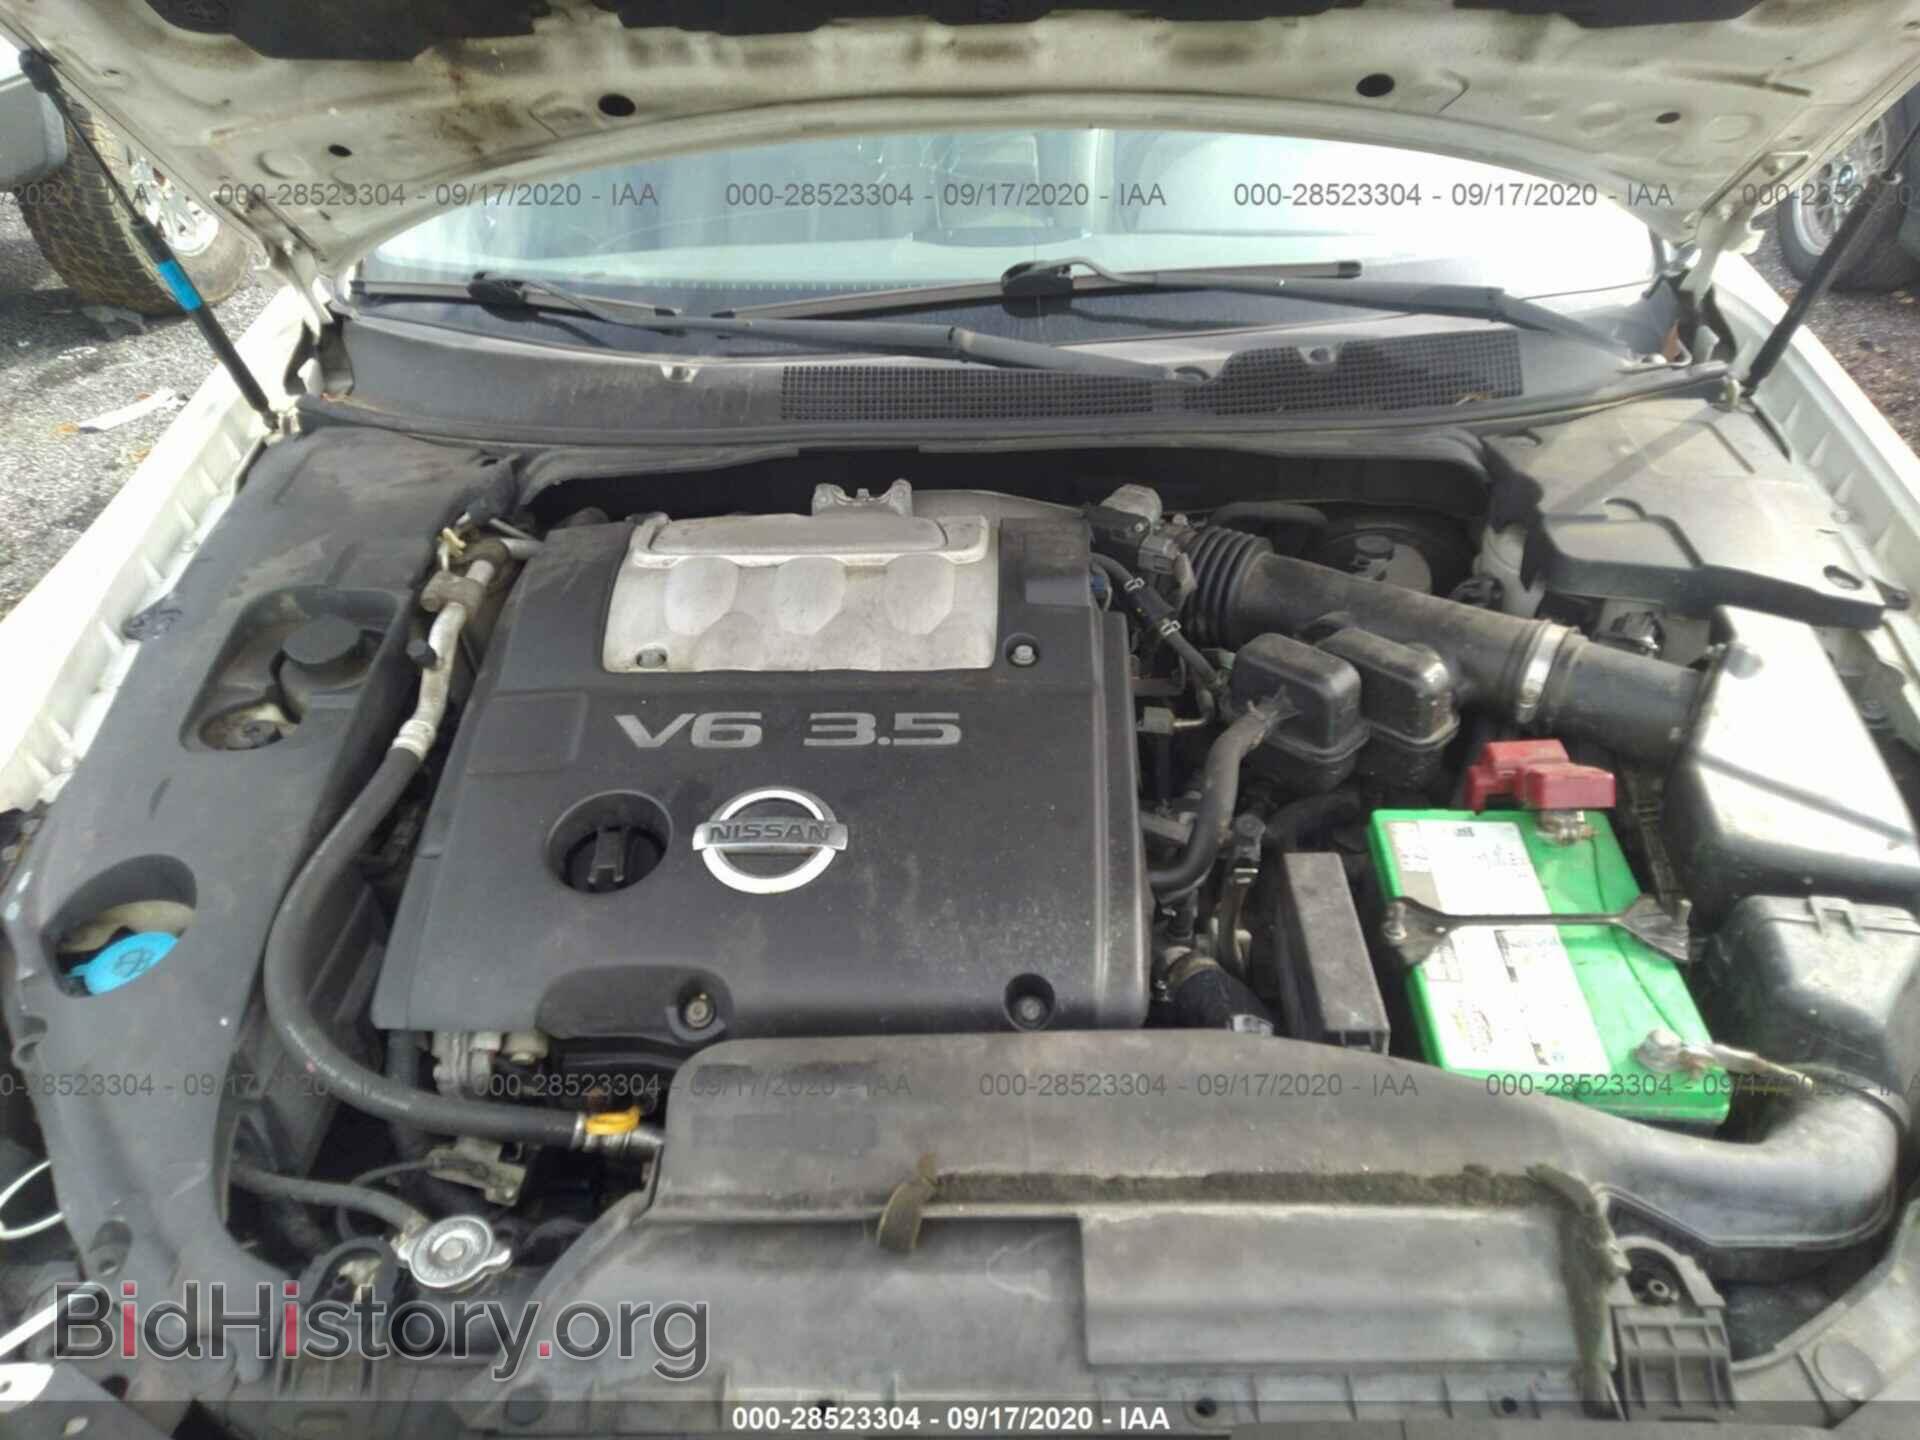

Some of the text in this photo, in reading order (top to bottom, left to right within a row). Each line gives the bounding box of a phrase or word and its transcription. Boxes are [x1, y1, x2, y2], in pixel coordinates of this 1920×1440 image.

[614, 712, 962, 748] V6 3.5
[709, 823, 831, 842] NISSAN
